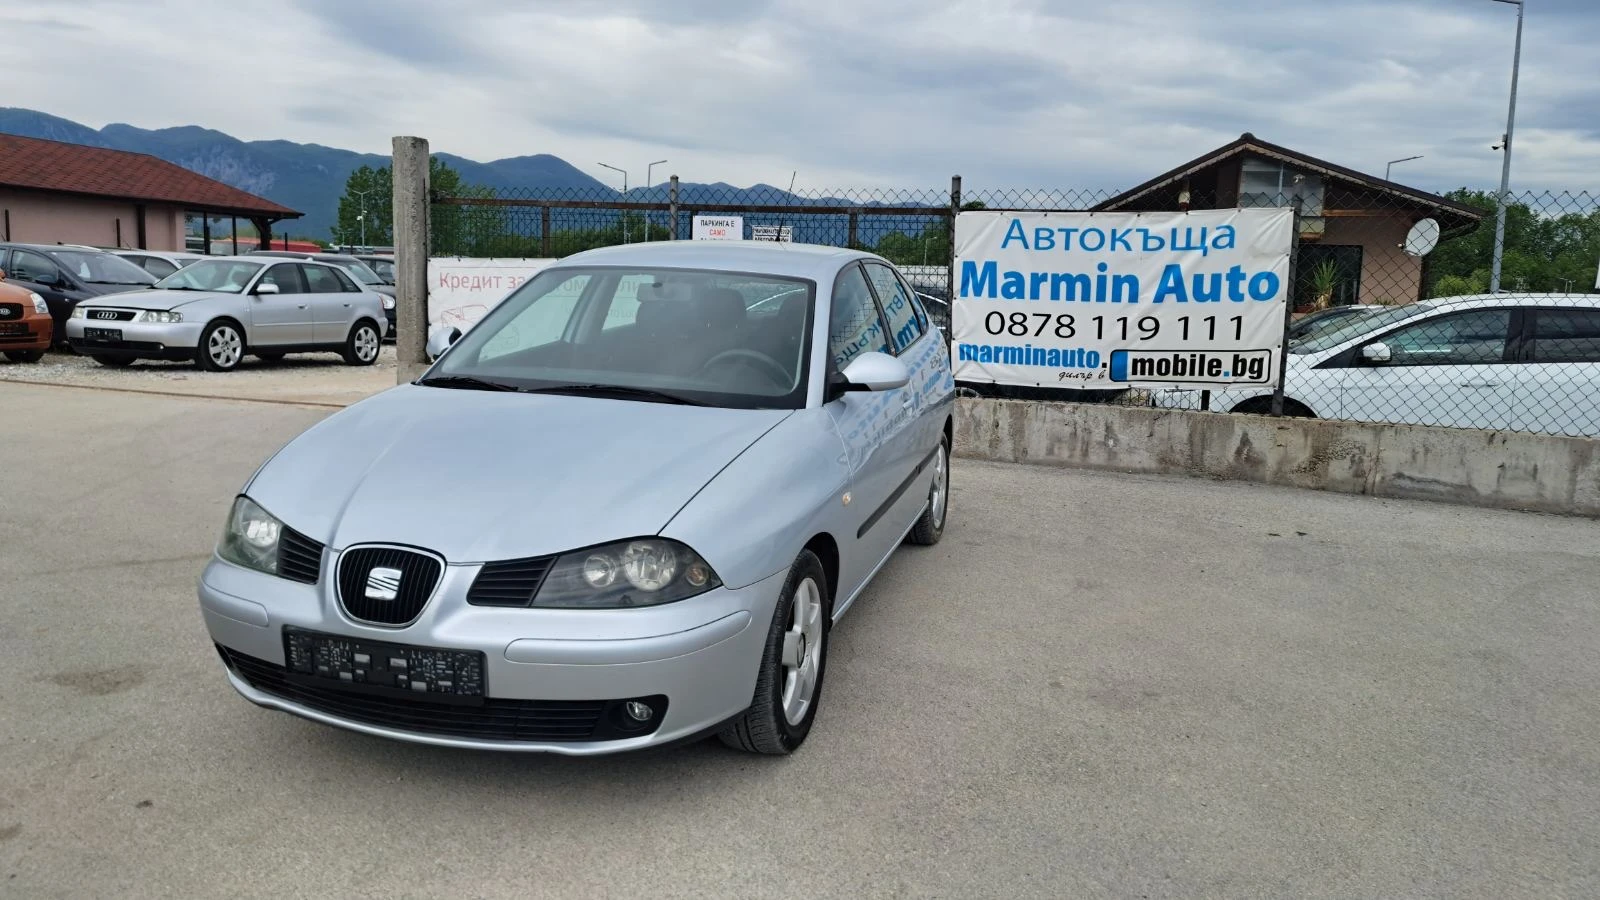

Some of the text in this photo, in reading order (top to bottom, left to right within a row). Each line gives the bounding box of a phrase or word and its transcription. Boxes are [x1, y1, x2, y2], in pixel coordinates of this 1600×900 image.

[700, 219, 730, 228] ПАРКИНГА
[1000, 218, 1236, 257] Автокъща
[439, 272, 503, 292] Кредит
[960, 260, 1280, 304] Marmin Auto
[984, 310, 1244, 341] 0878 119 111
[1131, 353, 1265, 380] mobile.bg
